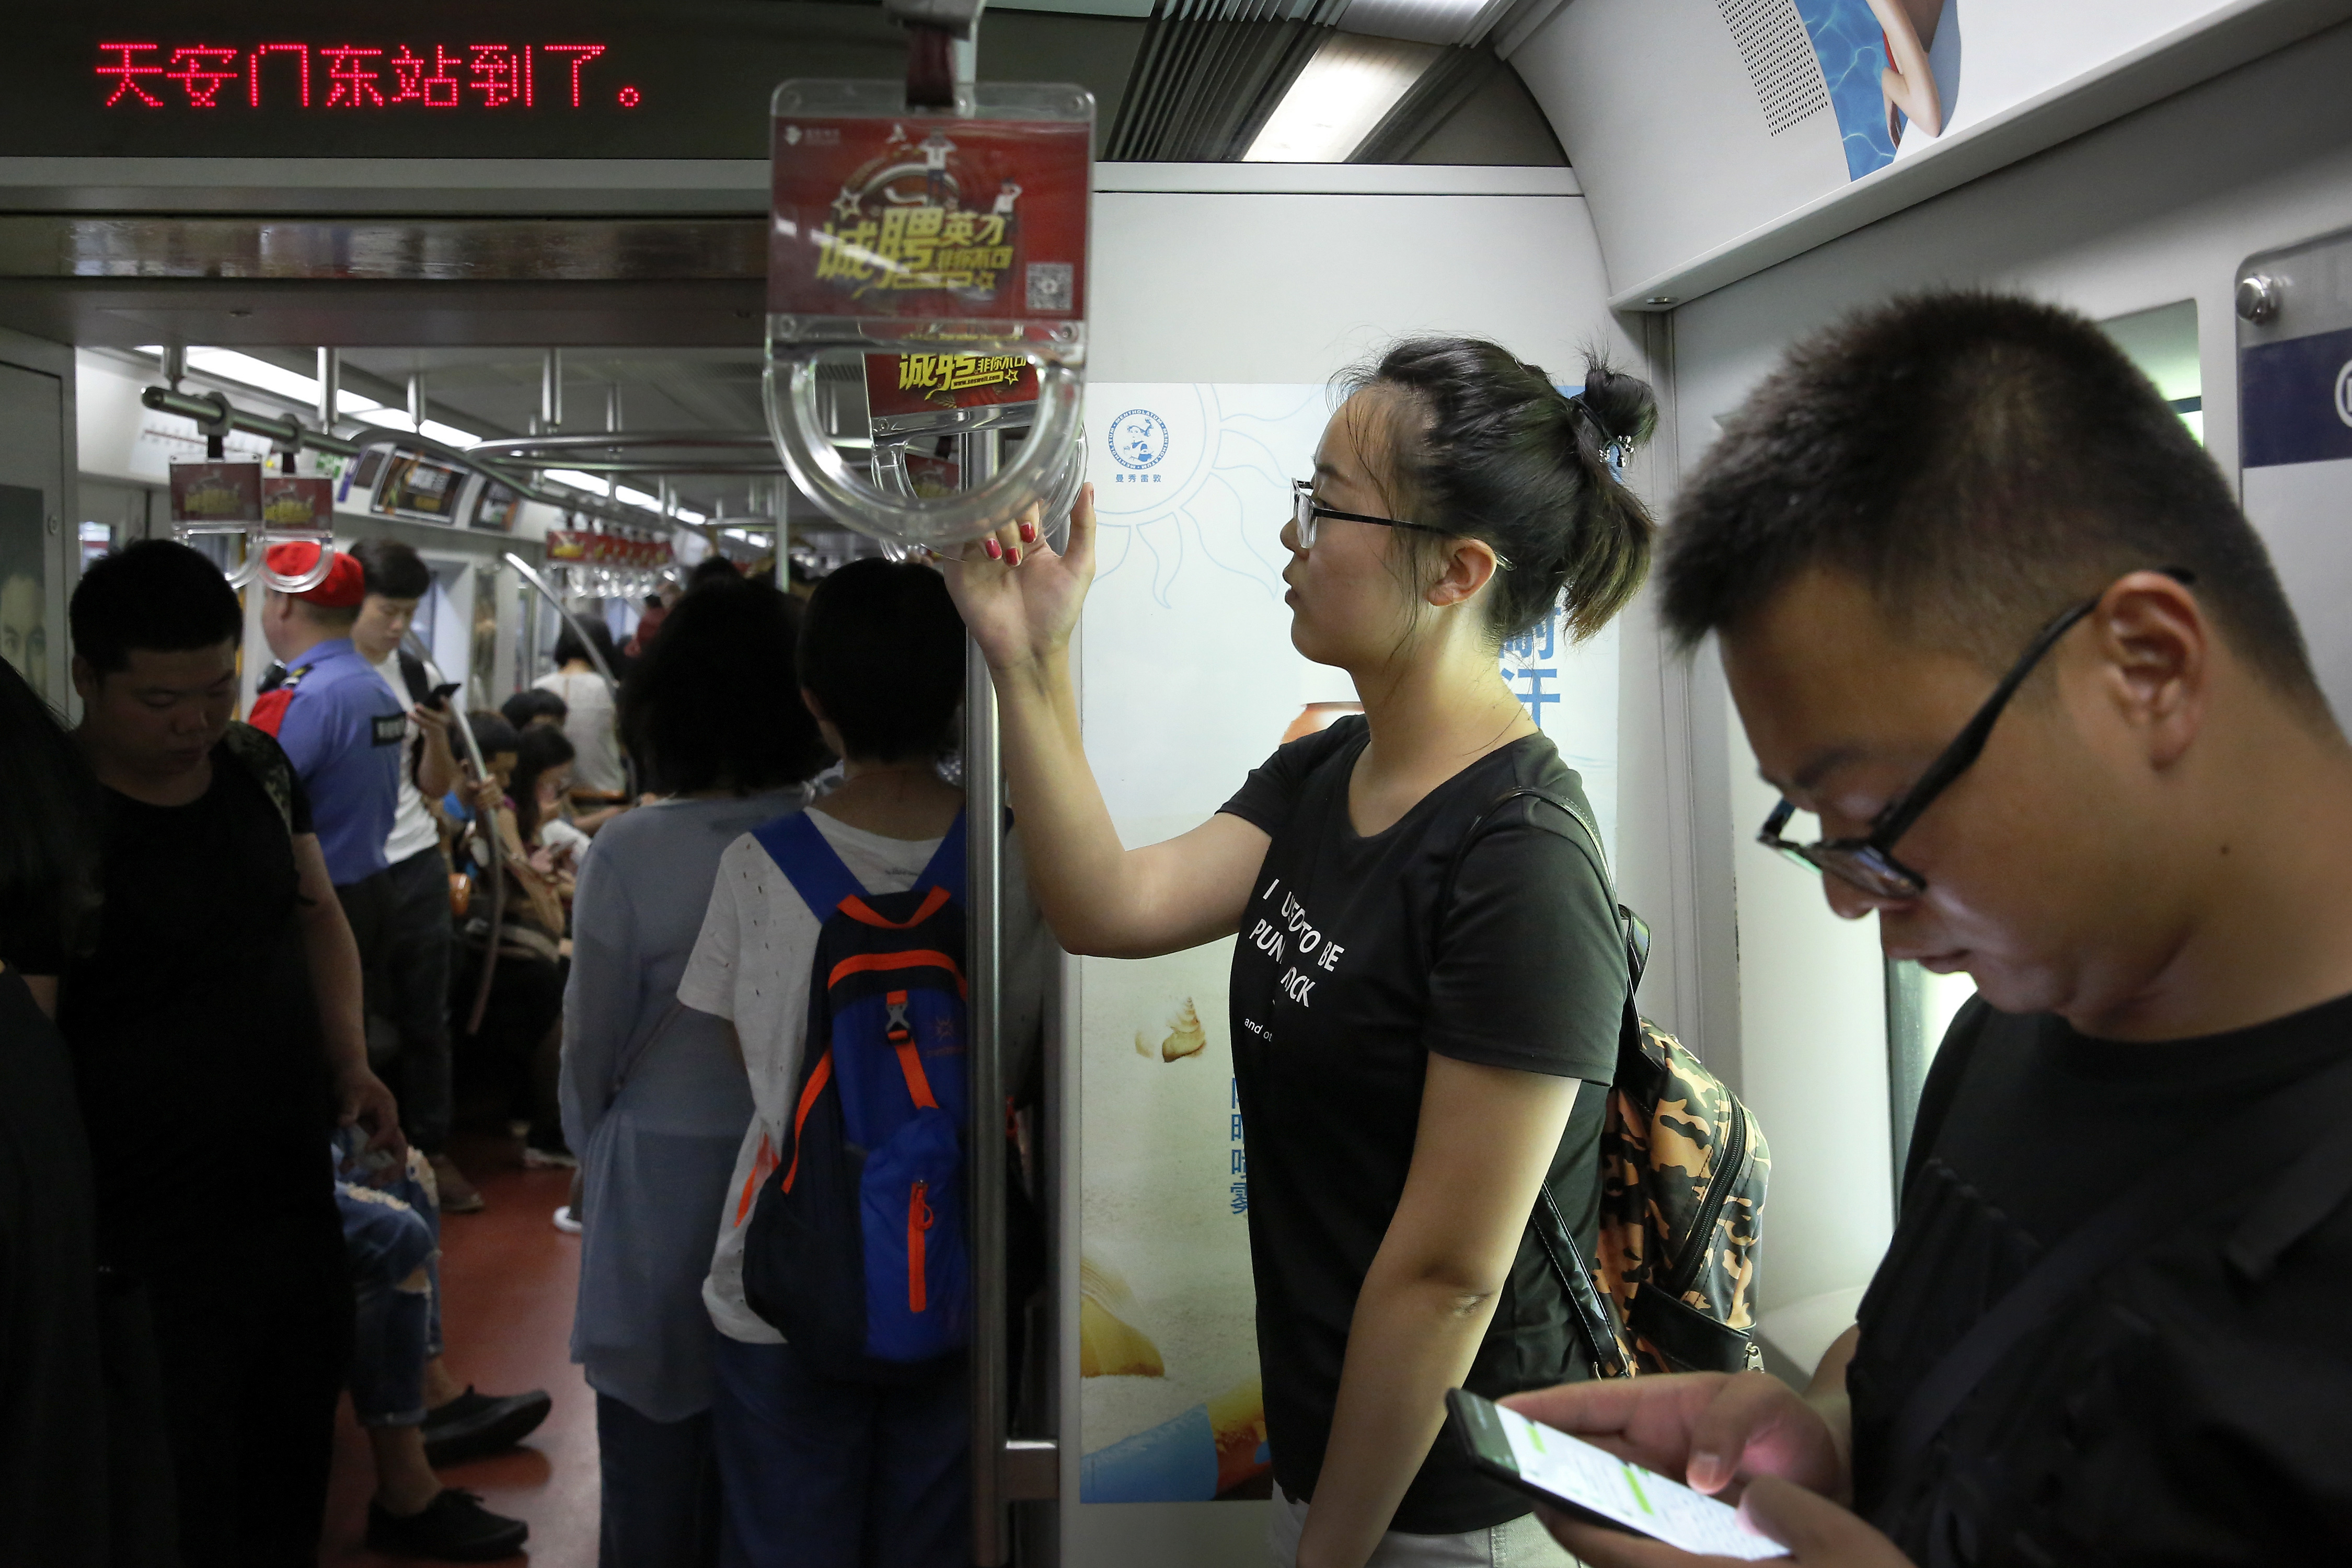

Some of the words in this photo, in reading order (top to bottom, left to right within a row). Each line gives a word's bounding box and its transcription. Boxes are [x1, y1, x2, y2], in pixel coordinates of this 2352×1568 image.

[96, 43, 641, 108] 天安门东站到了。
[1115, 409, 1162, 424] MENTHOLATUM
[1115, 474, 1161, 483] 曼秀雷敦
[1262, 878, 1280, 900] I
[1317, 941, 1345, 972] BE
[1244, 1018, 1263, 1034] and
[1263, 1031, 1273, 1042] ot
